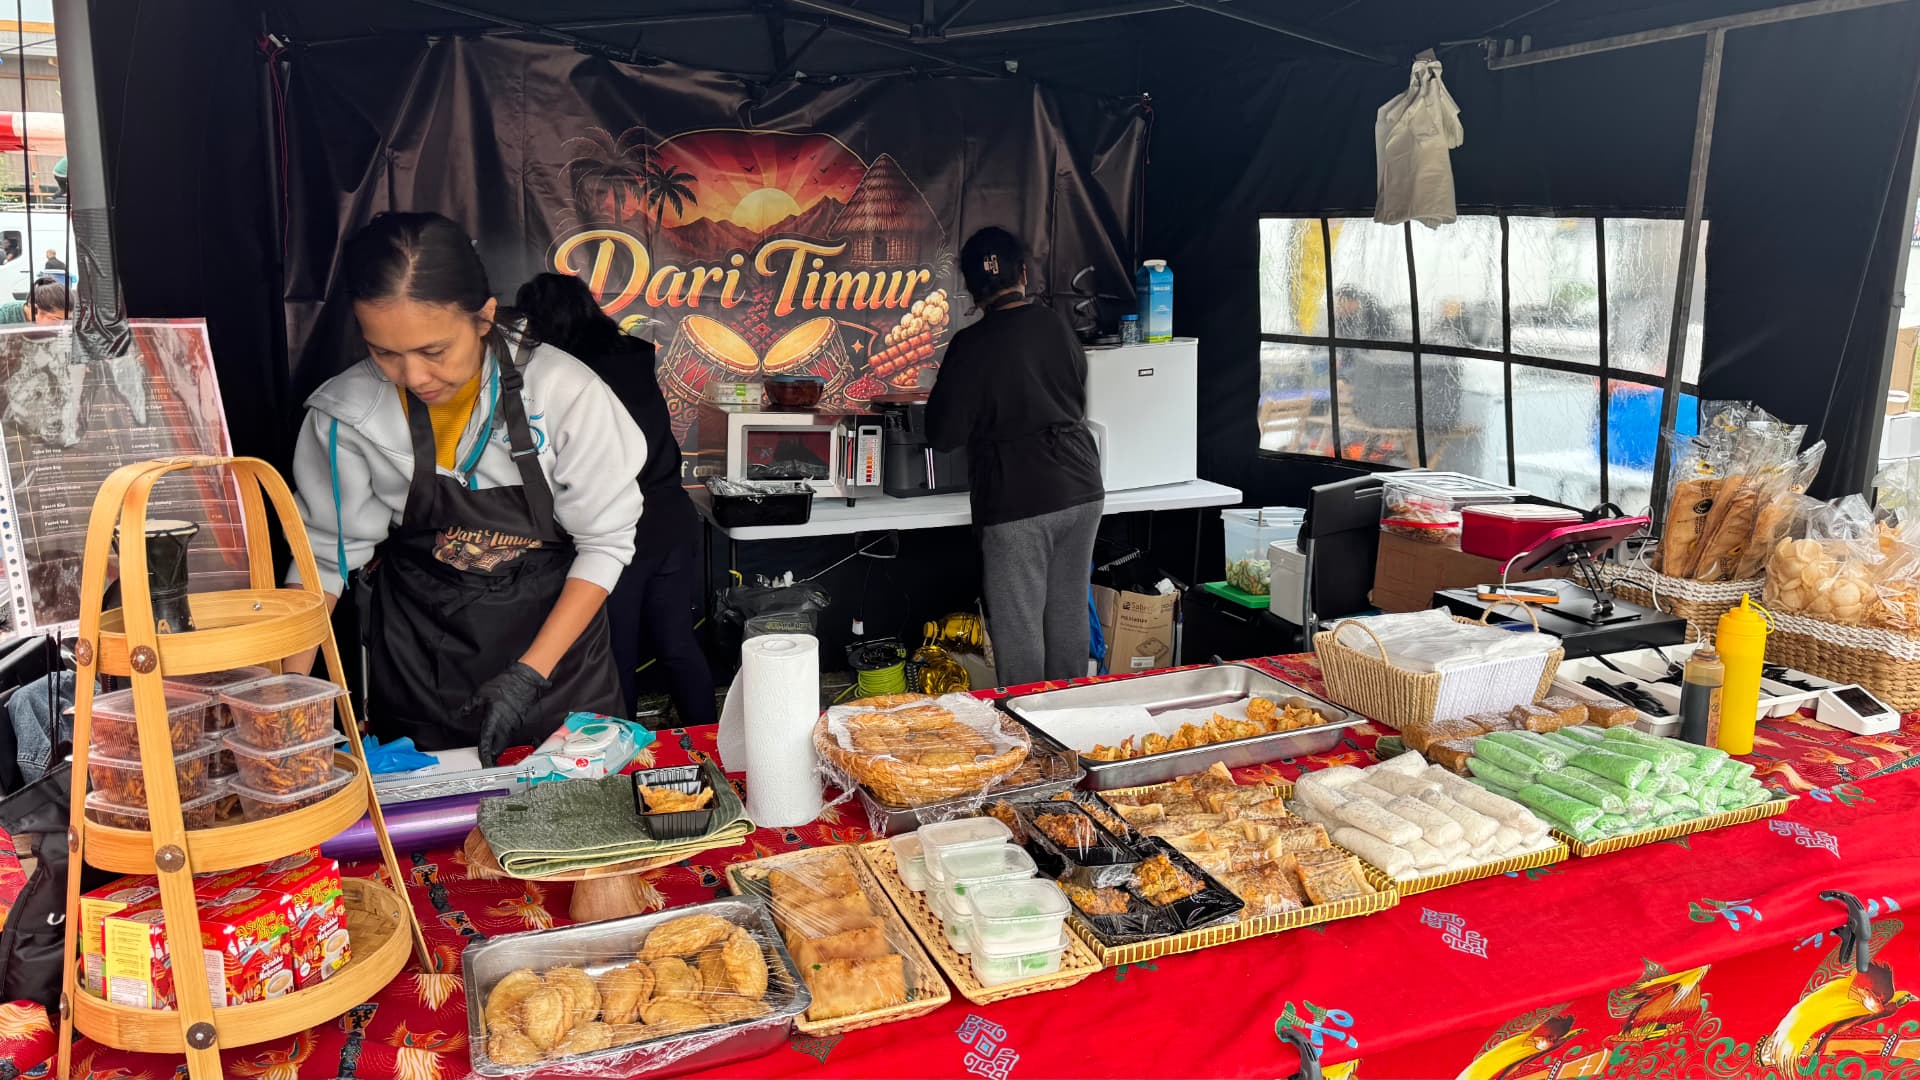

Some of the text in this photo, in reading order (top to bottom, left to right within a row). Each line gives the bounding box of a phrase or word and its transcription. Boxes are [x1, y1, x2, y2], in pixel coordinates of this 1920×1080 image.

[554, 229, 931, 317] Dari Timur
[445, 526, 483, 544] Dari
